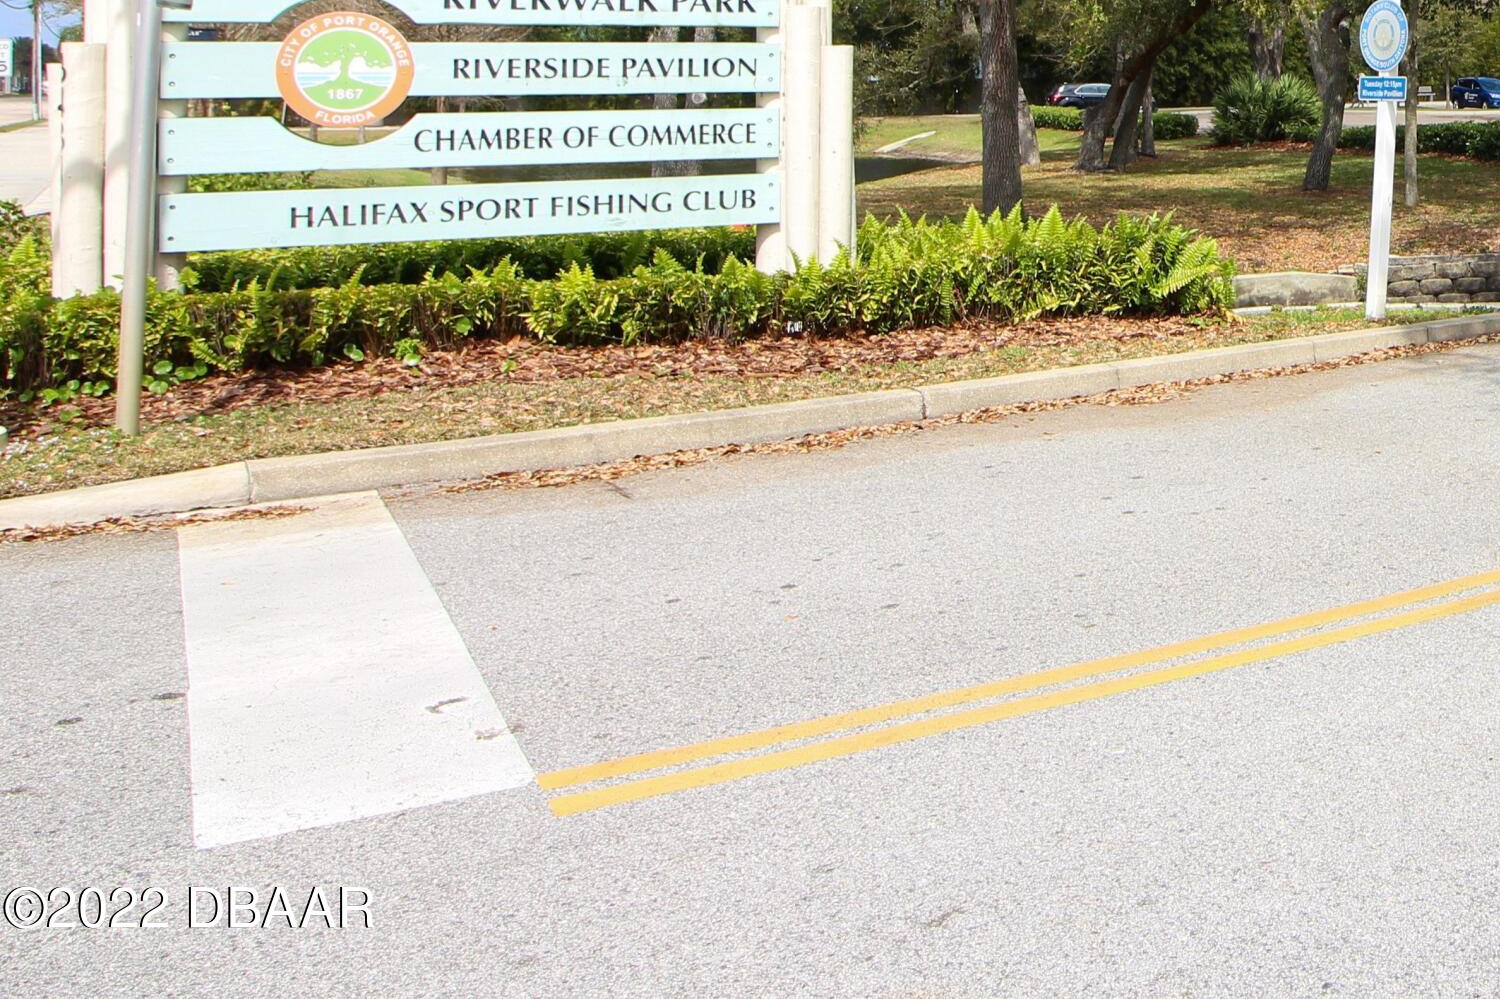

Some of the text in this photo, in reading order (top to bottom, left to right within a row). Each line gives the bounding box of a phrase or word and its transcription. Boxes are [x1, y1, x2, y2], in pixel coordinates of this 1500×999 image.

[280, 15, 410, 67] CITY OF PORT ORANGE
[453, 57, 757, 80] RIVERSIDE PAVILION
[327, 88, 364, 100] 1867
[315, 110, 376, 125] FLORIDA
[414, 122, 757, 152] CHAMBER OF COMMERCE
[290, 189, 756, 229] HALIFAX SPORT FISHING CLUB
